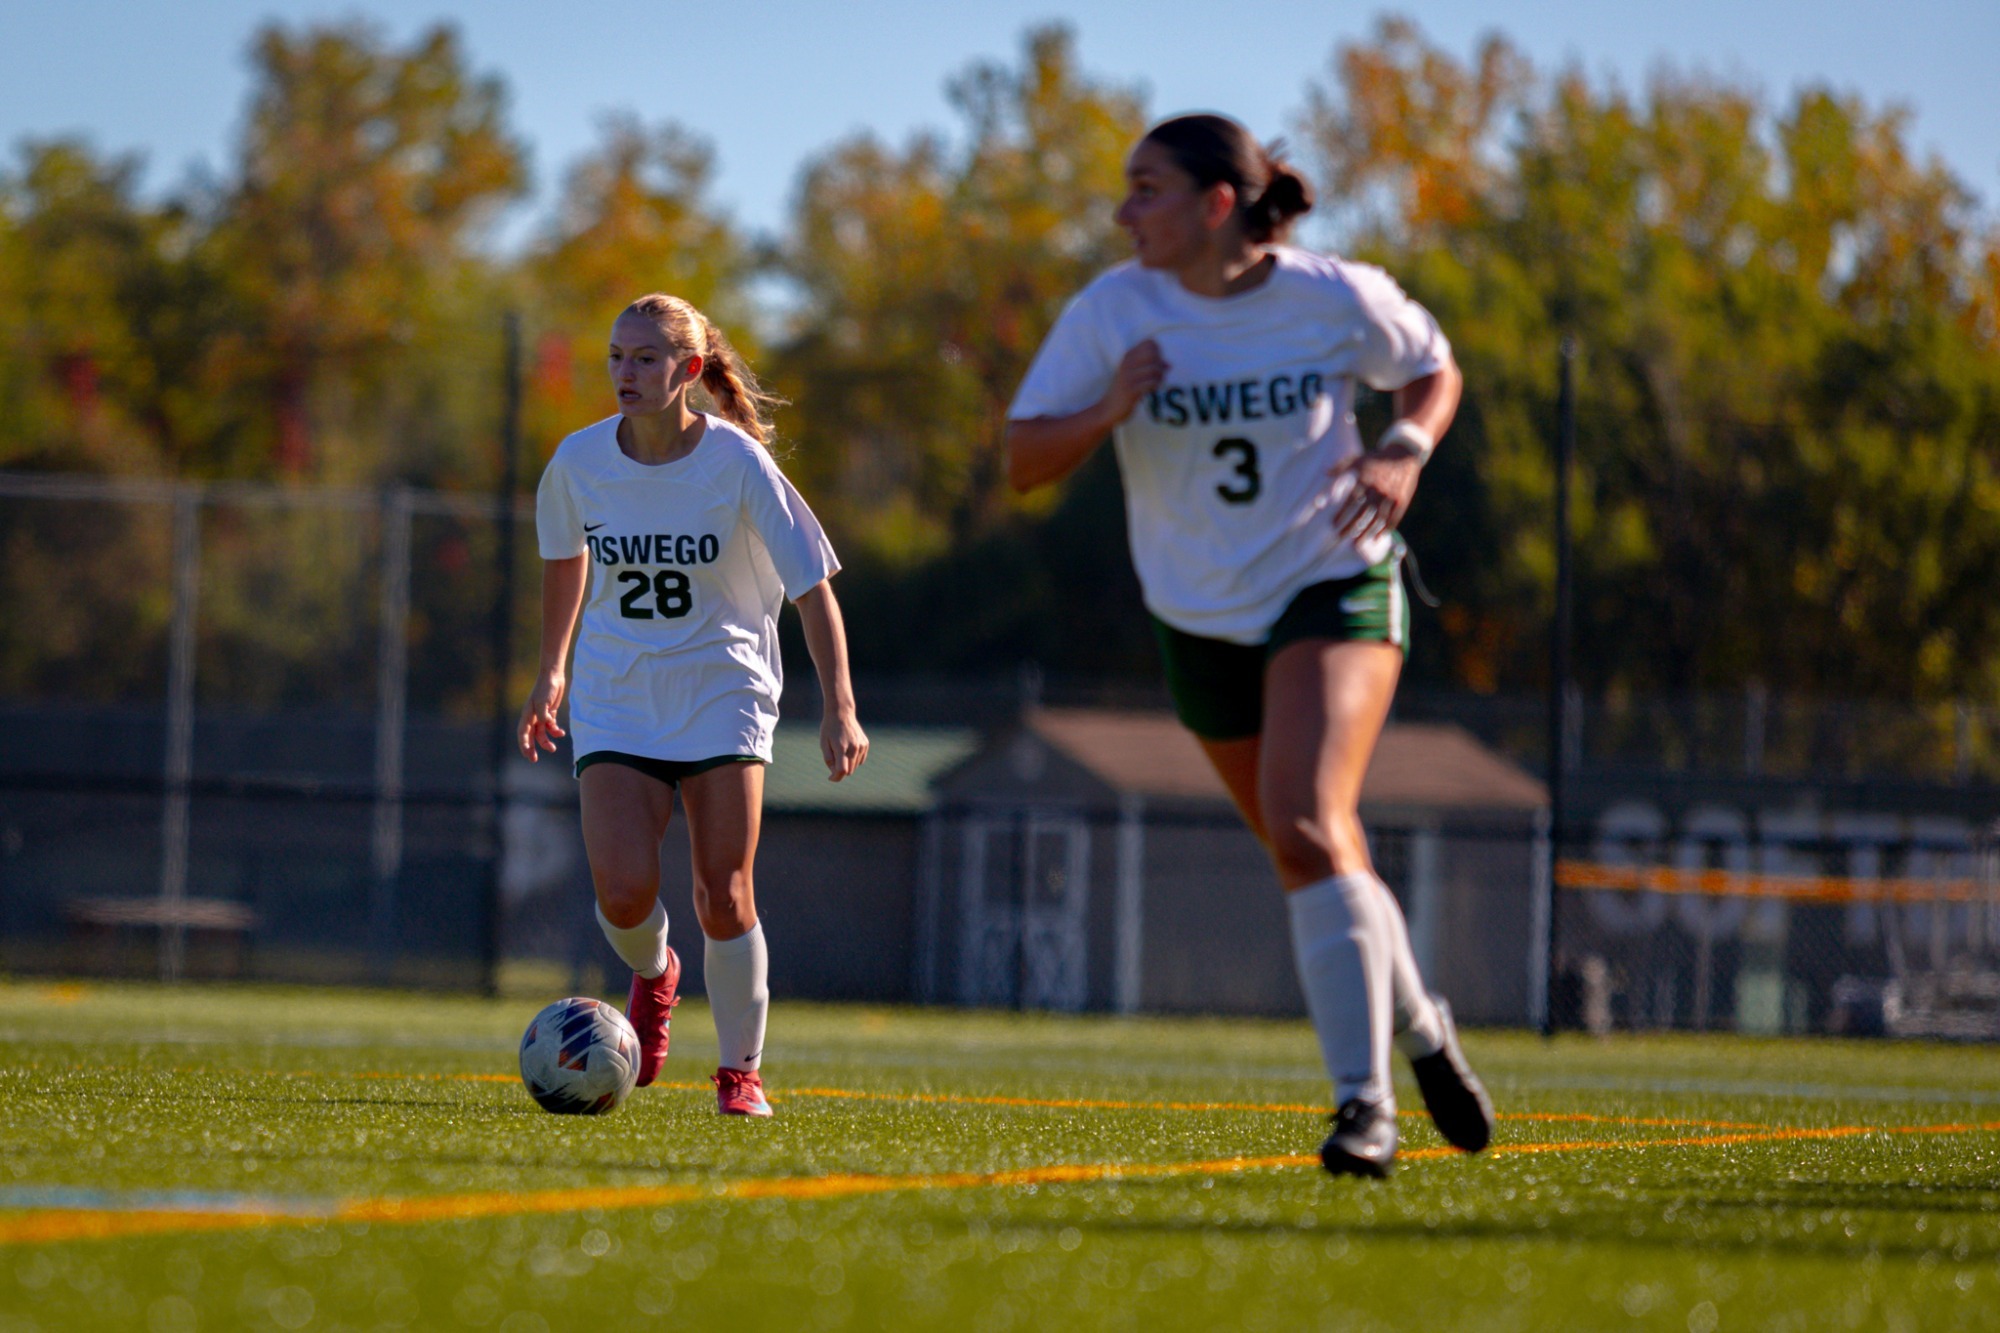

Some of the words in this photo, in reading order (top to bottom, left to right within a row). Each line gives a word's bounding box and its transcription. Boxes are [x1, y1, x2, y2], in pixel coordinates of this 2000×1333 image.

[1212, 437, 1261, 505] 3
[586, 533, 720, 566] OSWEGO
[617, 570, 693, 619] 28
